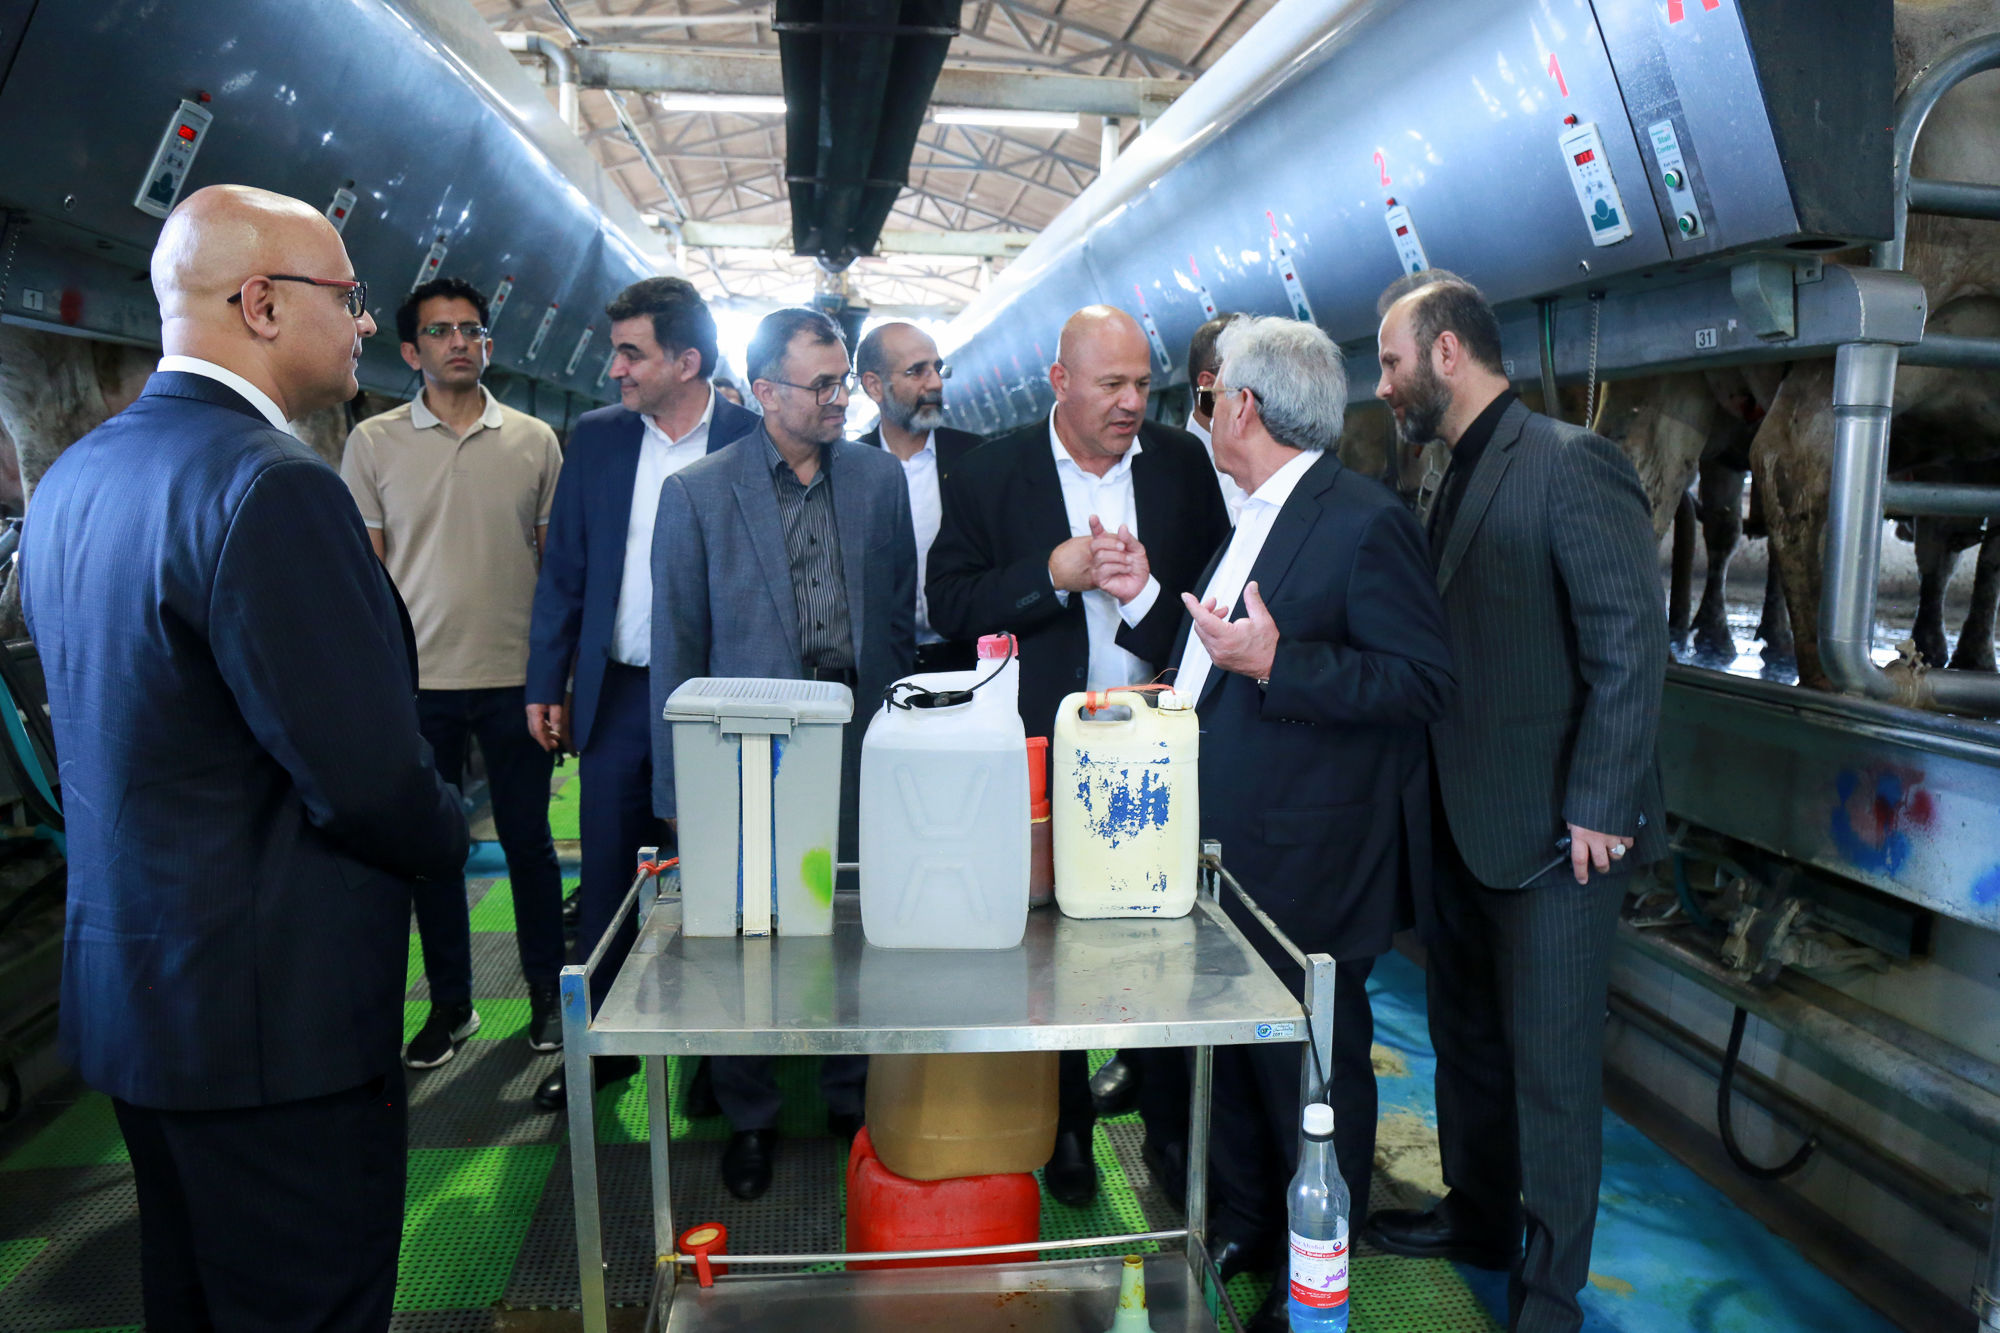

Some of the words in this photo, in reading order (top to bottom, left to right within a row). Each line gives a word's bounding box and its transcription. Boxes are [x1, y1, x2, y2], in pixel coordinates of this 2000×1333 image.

[1547, 53, 1569, 98] 1
[1655, 141, 1677, 154] Control
[1657, 134, 1671, 145] Stall
[1373, 151, 1392, 187] 2
[1266, 210, 1279, 238] 3
[30, 292, 36, 308] 1
[1698, 331, 1712, 347] 31
